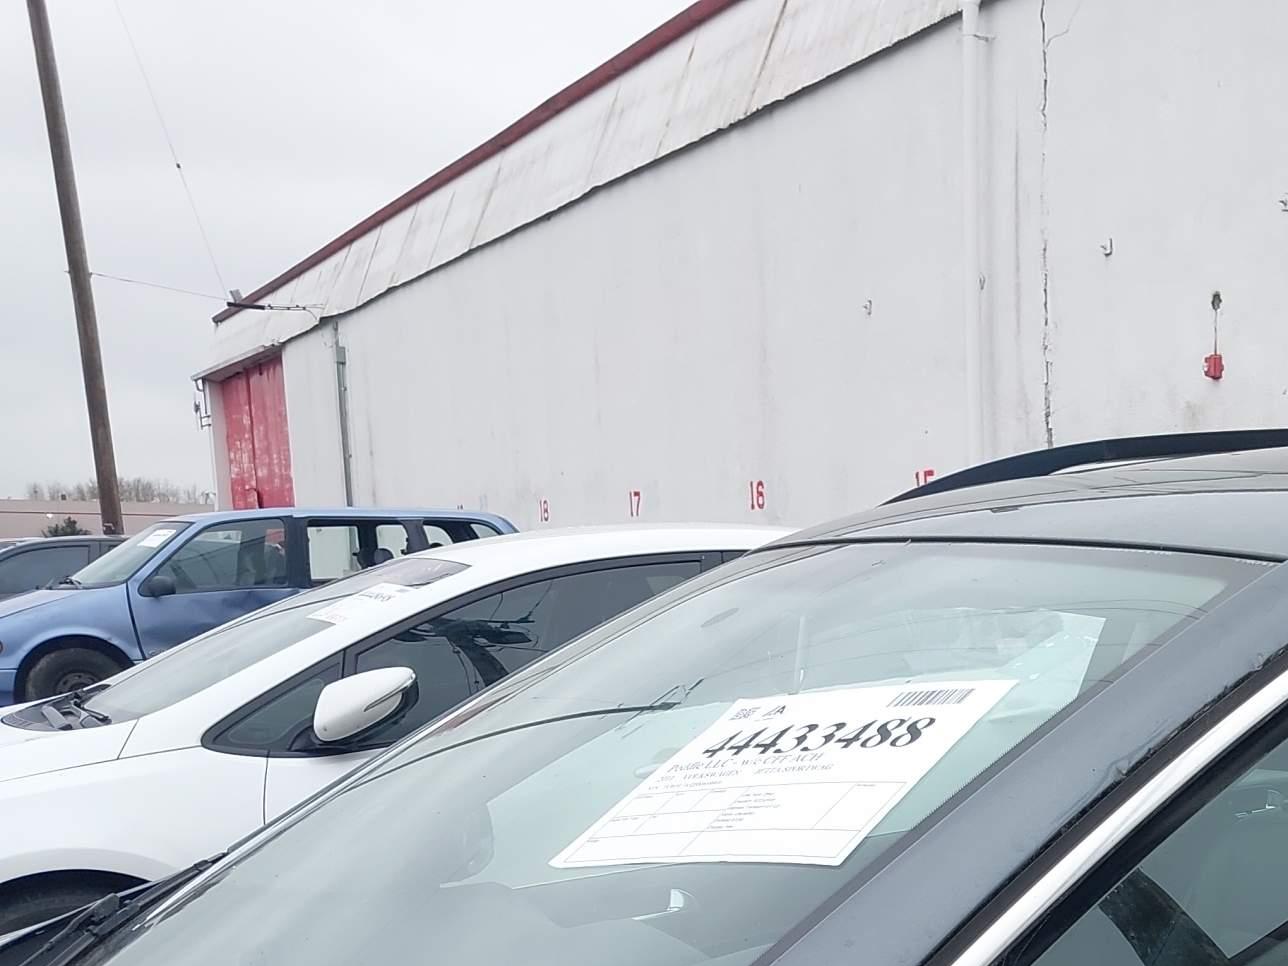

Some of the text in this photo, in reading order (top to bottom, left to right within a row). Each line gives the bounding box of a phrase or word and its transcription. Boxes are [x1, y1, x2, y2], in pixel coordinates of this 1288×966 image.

[629, 491, 642, 518] 17
[750, 480, 766, 511] 16
[539, 499, 550, 522] 18
[702, 716, 936, 759] 44433488
